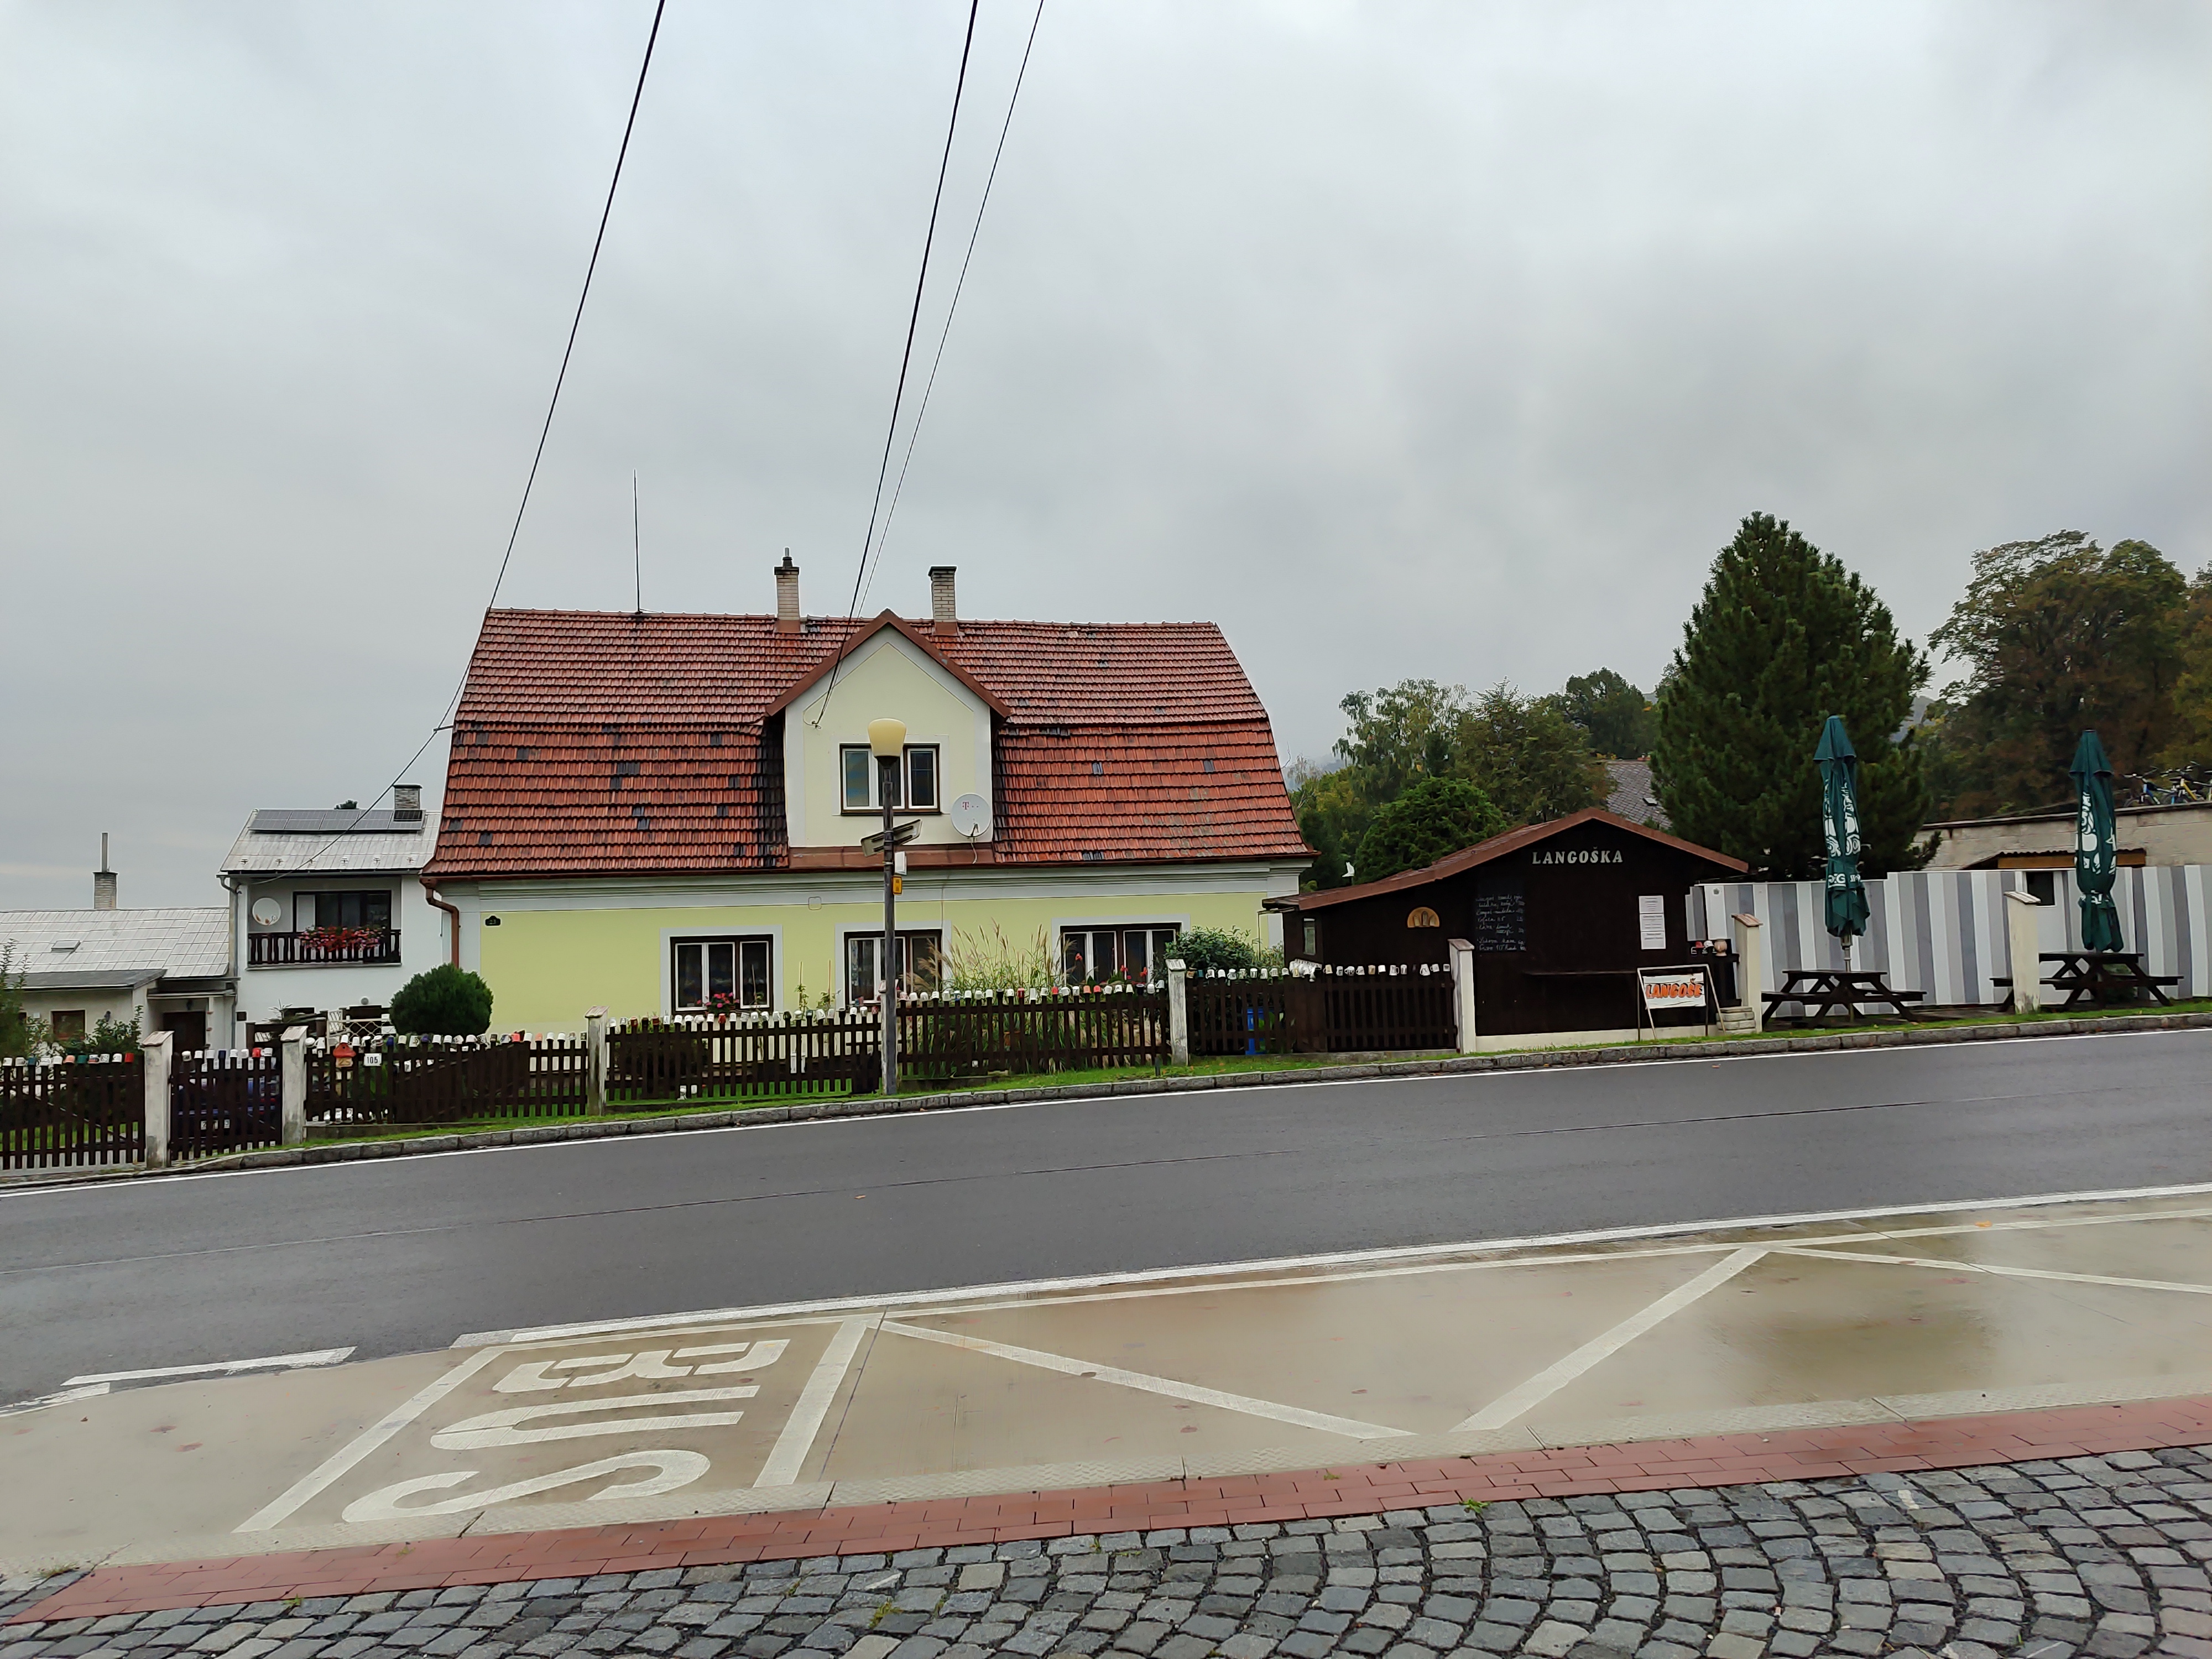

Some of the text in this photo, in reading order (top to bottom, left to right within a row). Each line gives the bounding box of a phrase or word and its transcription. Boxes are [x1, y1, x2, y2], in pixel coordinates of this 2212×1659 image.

[1532, 846, 1623, 864] LANGOŠKA
[1645, 978, 1704, 999] LANGOŠE
[341, 1339, 790, 1522] BUS
